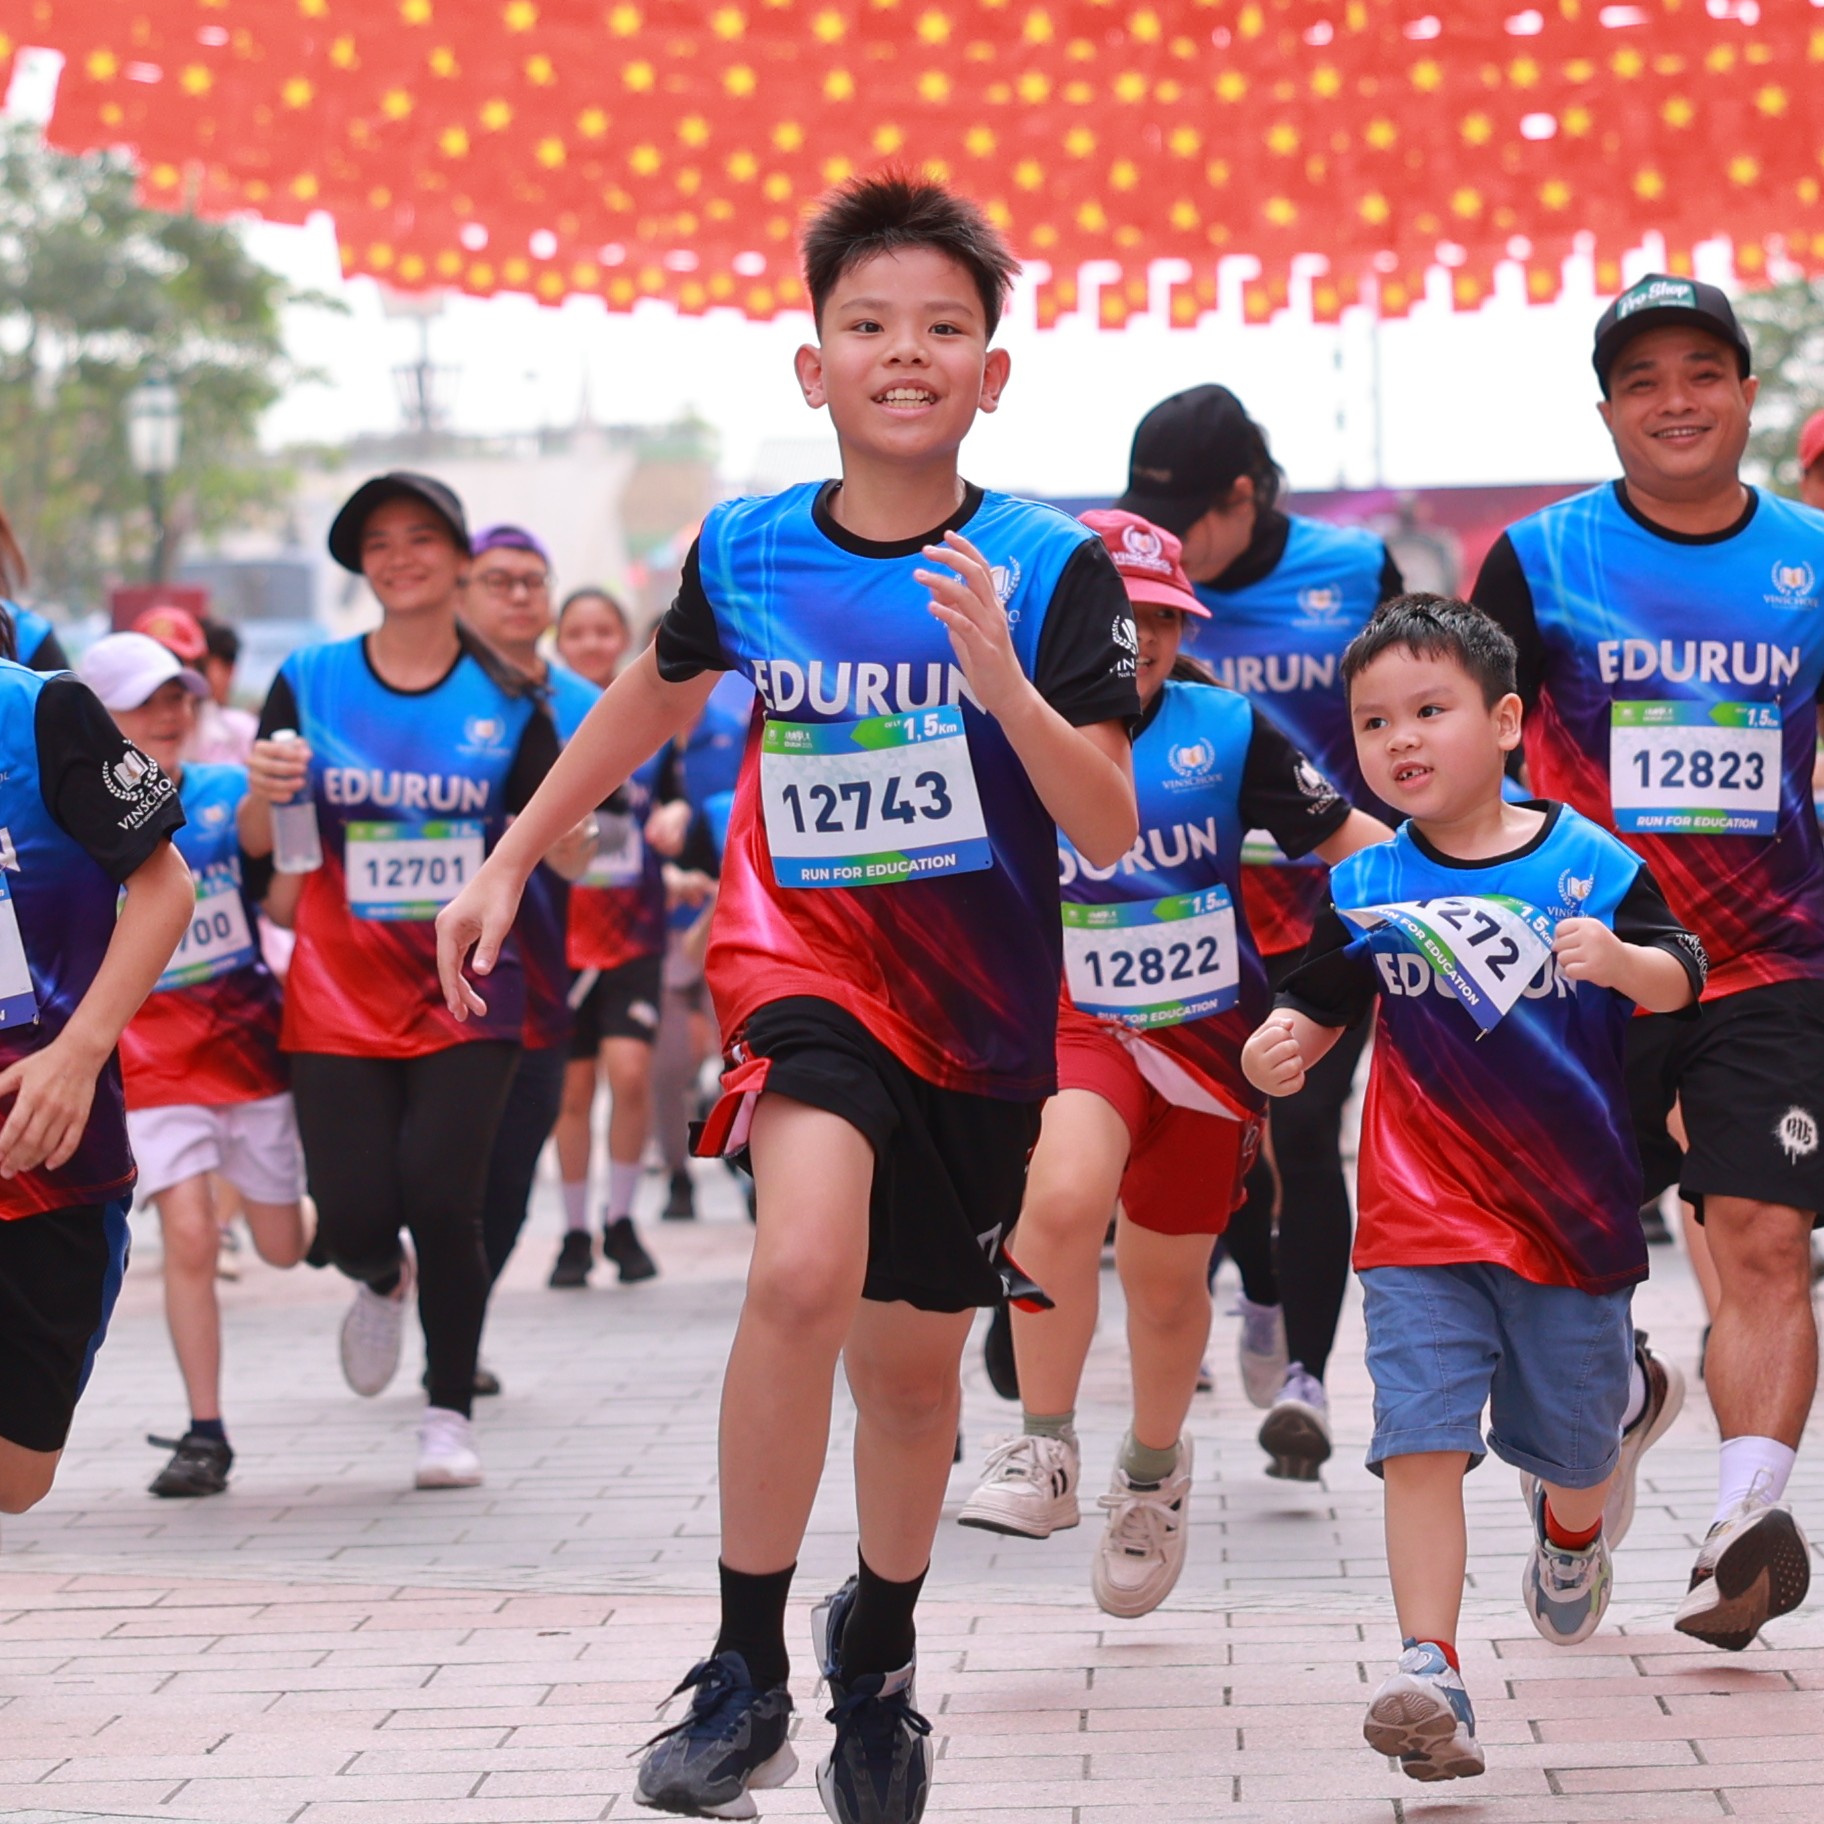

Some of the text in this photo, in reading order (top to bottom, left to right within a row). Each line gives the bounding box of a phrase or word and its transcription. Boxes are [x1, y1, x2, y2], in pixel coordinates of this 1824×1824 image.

[1597, 639, 1800, 685] EDURUN
[323, 767, 490, 812] EDURUN
[1633, 749, 1764, 790] 12823
[117, 778, 172, 830] VINSCHO
[782, 771, 952, 833] 12743
[1637, 816, 1758, 829] RUN FOR EDUCATION
[365, 857, 466, 890] 12701
[801, 853, 956, 880] RUN FOR EDUCATION
[1085, 936, 1220, 987] 12822
[1401, 917, 1425, 940] FOR
[1425, 939, 1479, 1006] EDUCATION
[1416, 900, 1519, 982] 272
[1150, 998, 1217, 1021] EDUCATION
